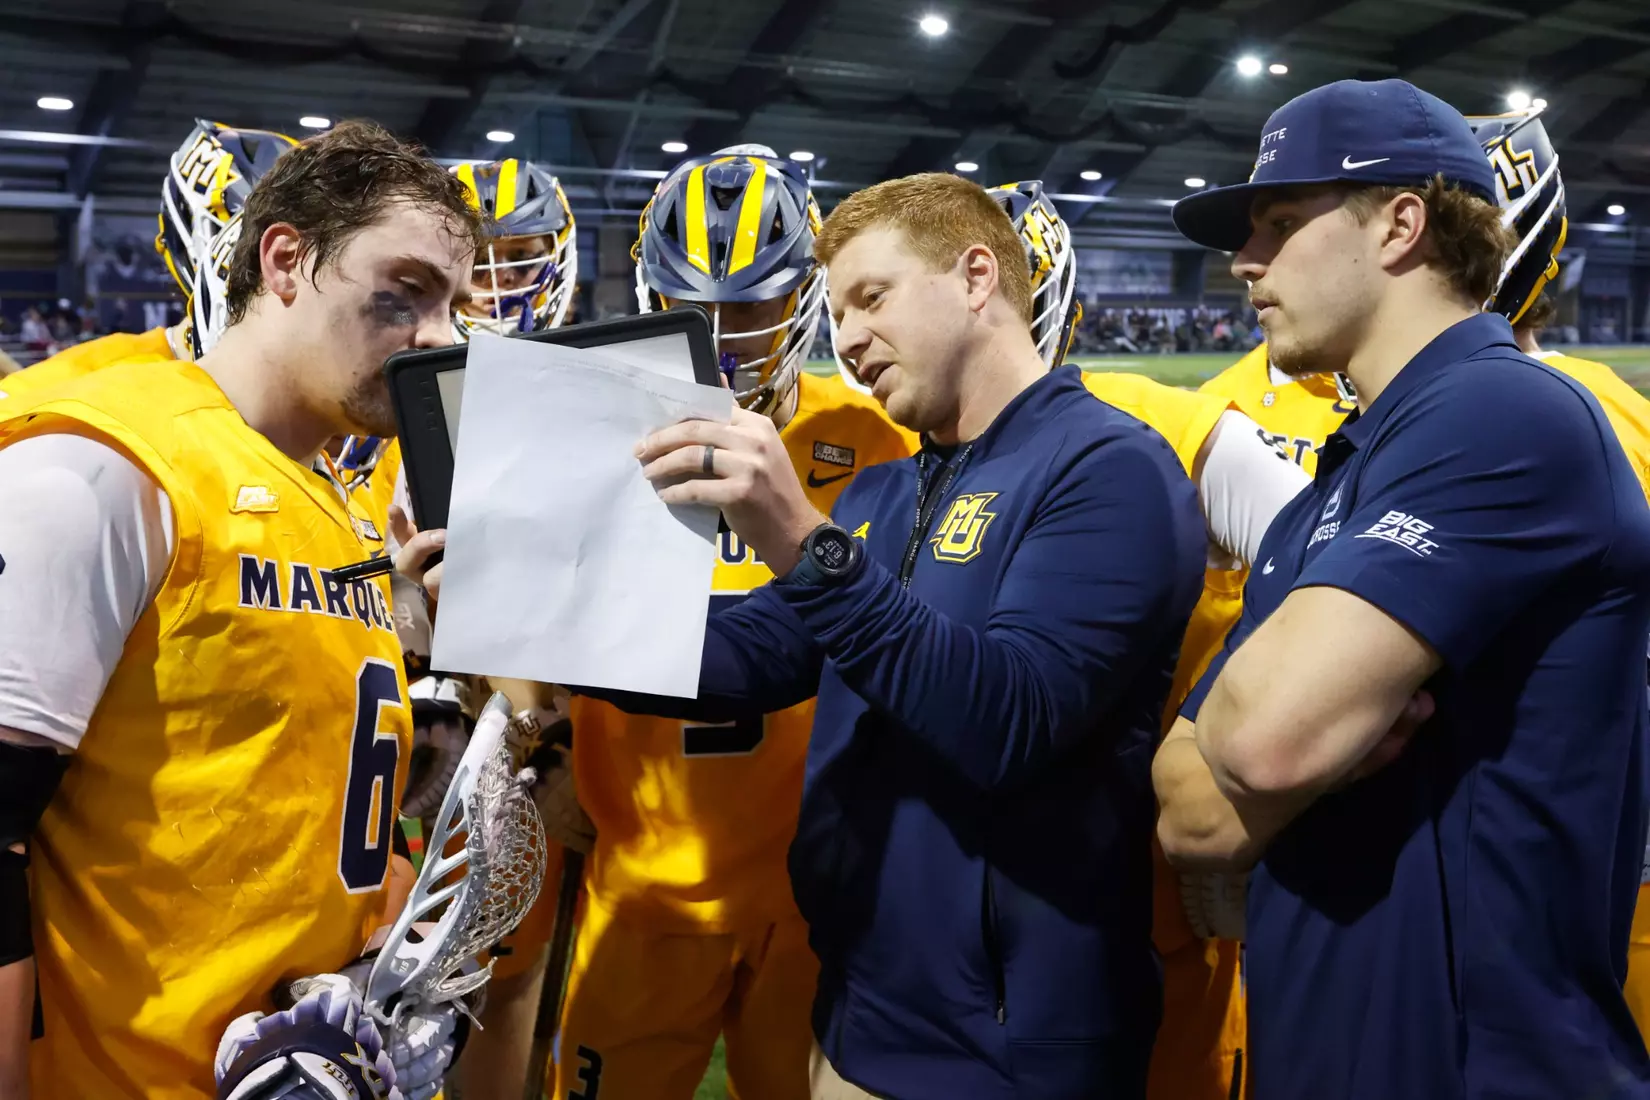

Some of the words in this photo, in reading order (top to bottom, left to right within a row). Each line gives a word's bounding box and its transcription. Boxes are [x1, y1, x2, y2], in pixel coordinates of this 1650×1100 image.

[932, 494, 995, 562] MU
[1378, 510, 1435, 534] BIG
[338, 656, 402, 894] 6
